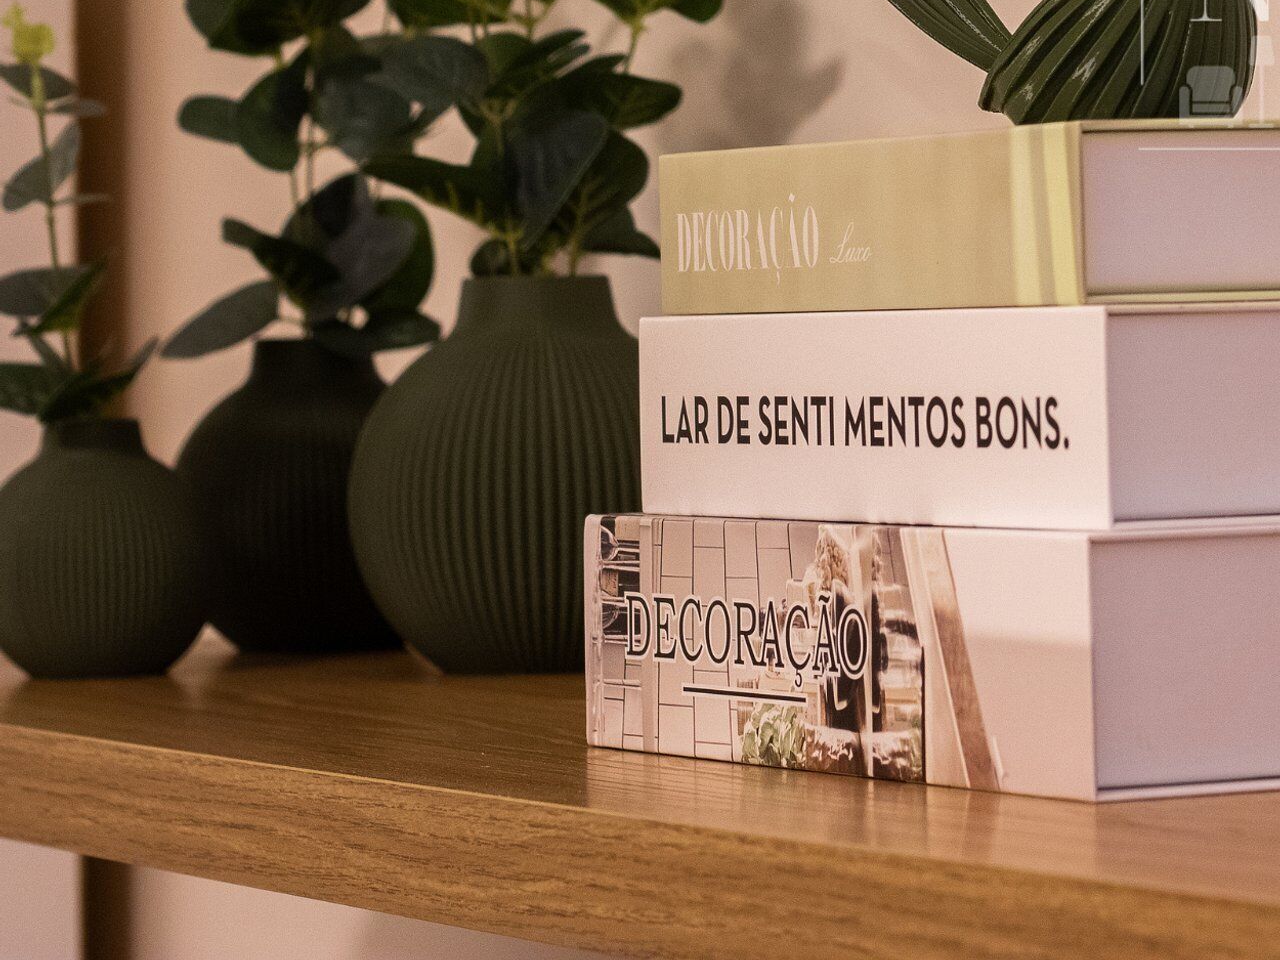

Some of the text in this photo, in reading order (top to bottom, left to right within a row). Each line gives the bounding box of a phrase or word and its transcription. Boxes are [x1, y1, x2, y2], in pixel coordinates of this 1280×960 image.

[661, 395, 710, 444] LAR
[717, 395, 750, 444] DE
[975, 395, 1070, 450] BONS.
[624, 593, 872, 688] DECORAÇÃO
